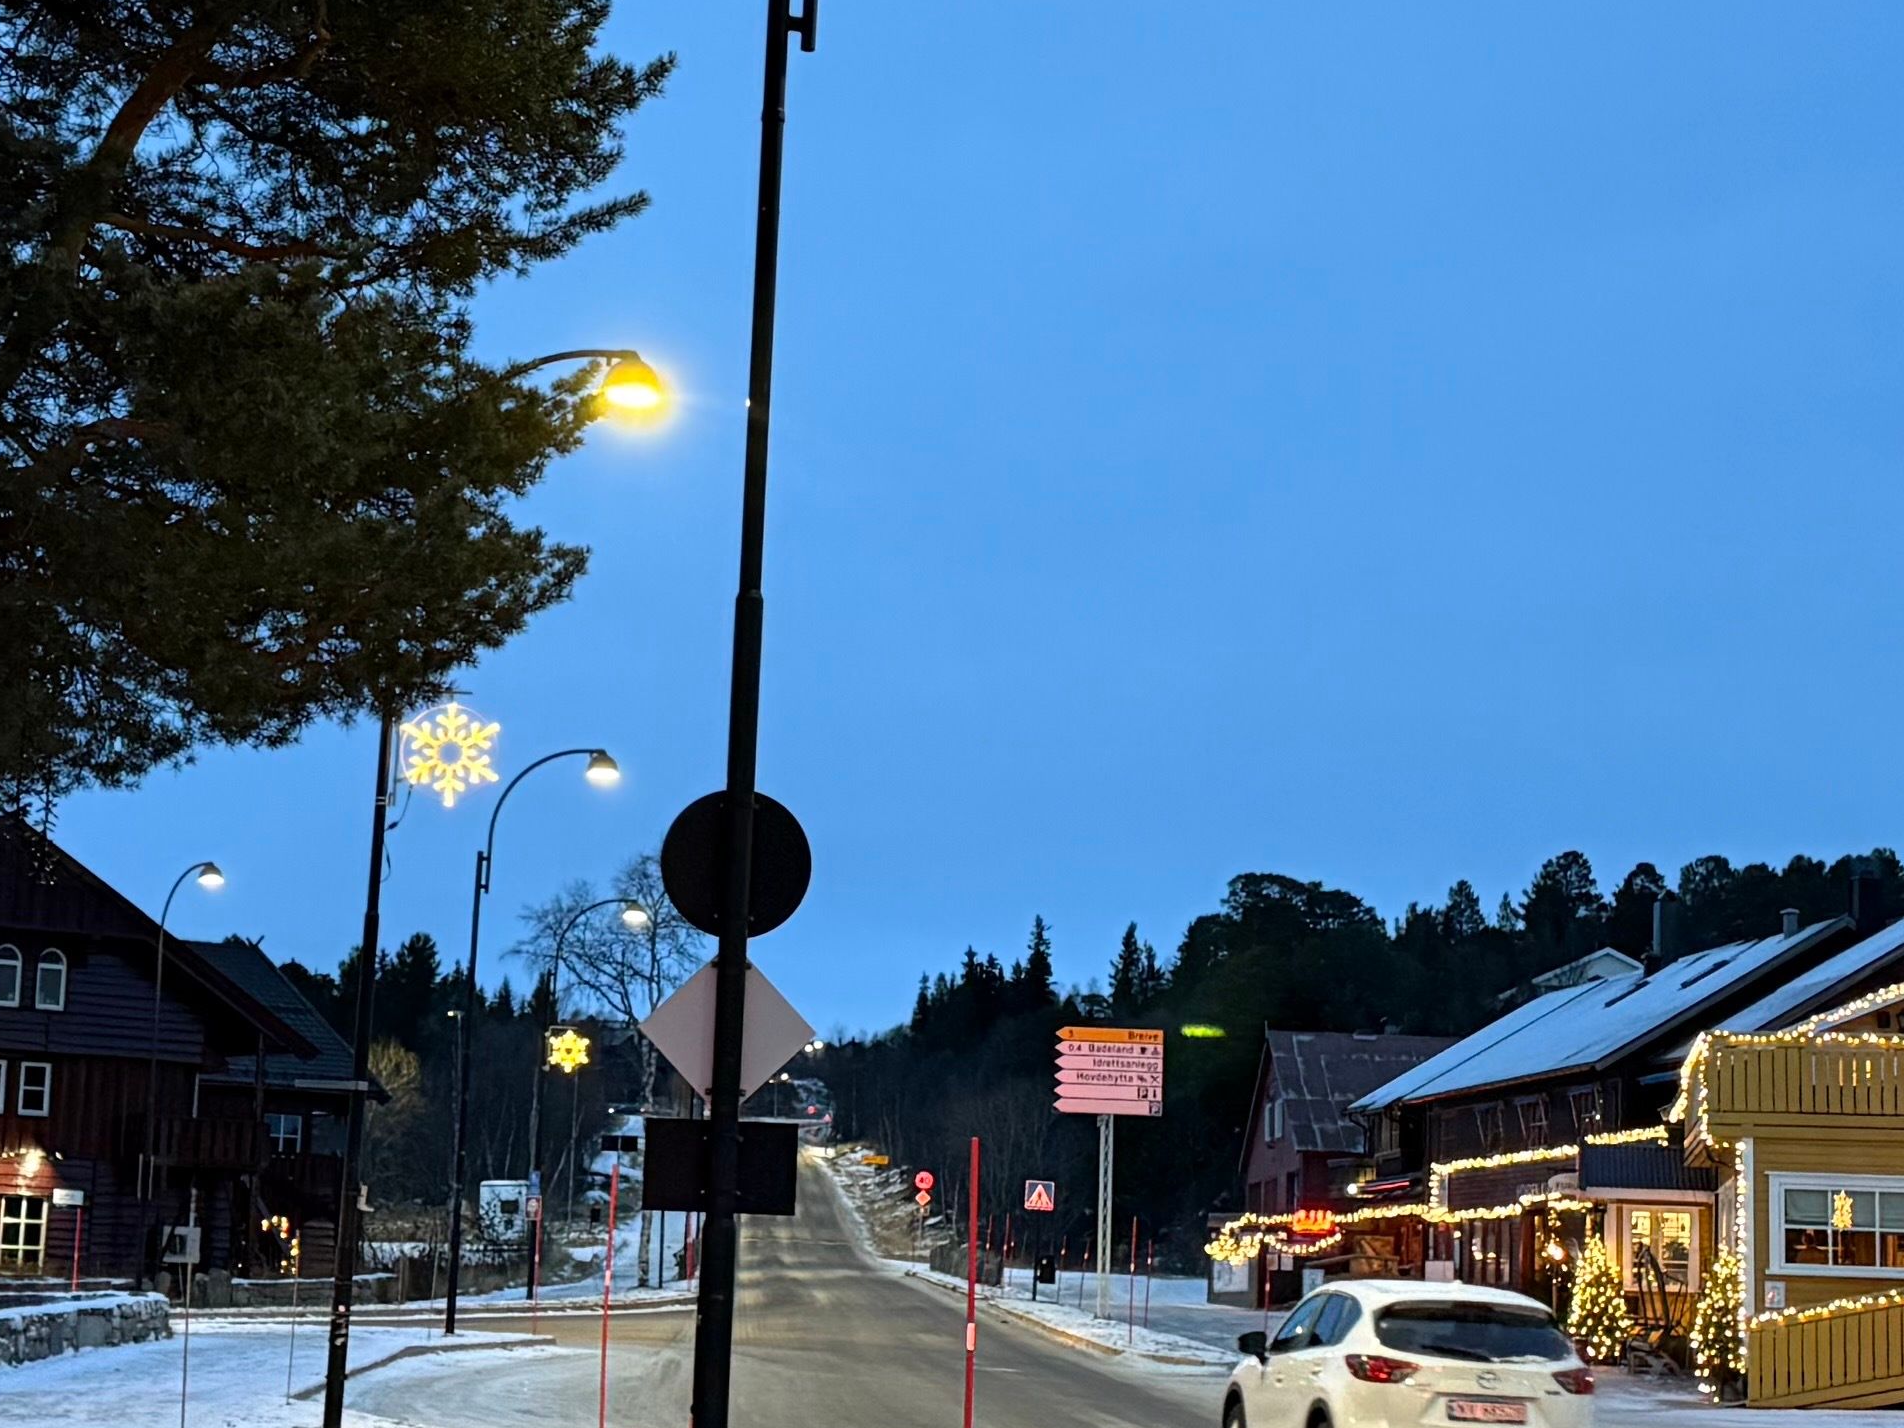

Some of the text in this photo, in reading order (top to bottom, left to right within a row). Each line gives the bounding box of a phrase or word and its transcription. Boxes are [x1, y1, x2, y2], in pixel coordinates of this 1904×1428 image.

[1088, 1044, 1134, 1054] Badeland
[1093, 1058, 1159, 1071] Idrettsanlegg
[1077, 1073, 1134, 1084] Hovdehytta
